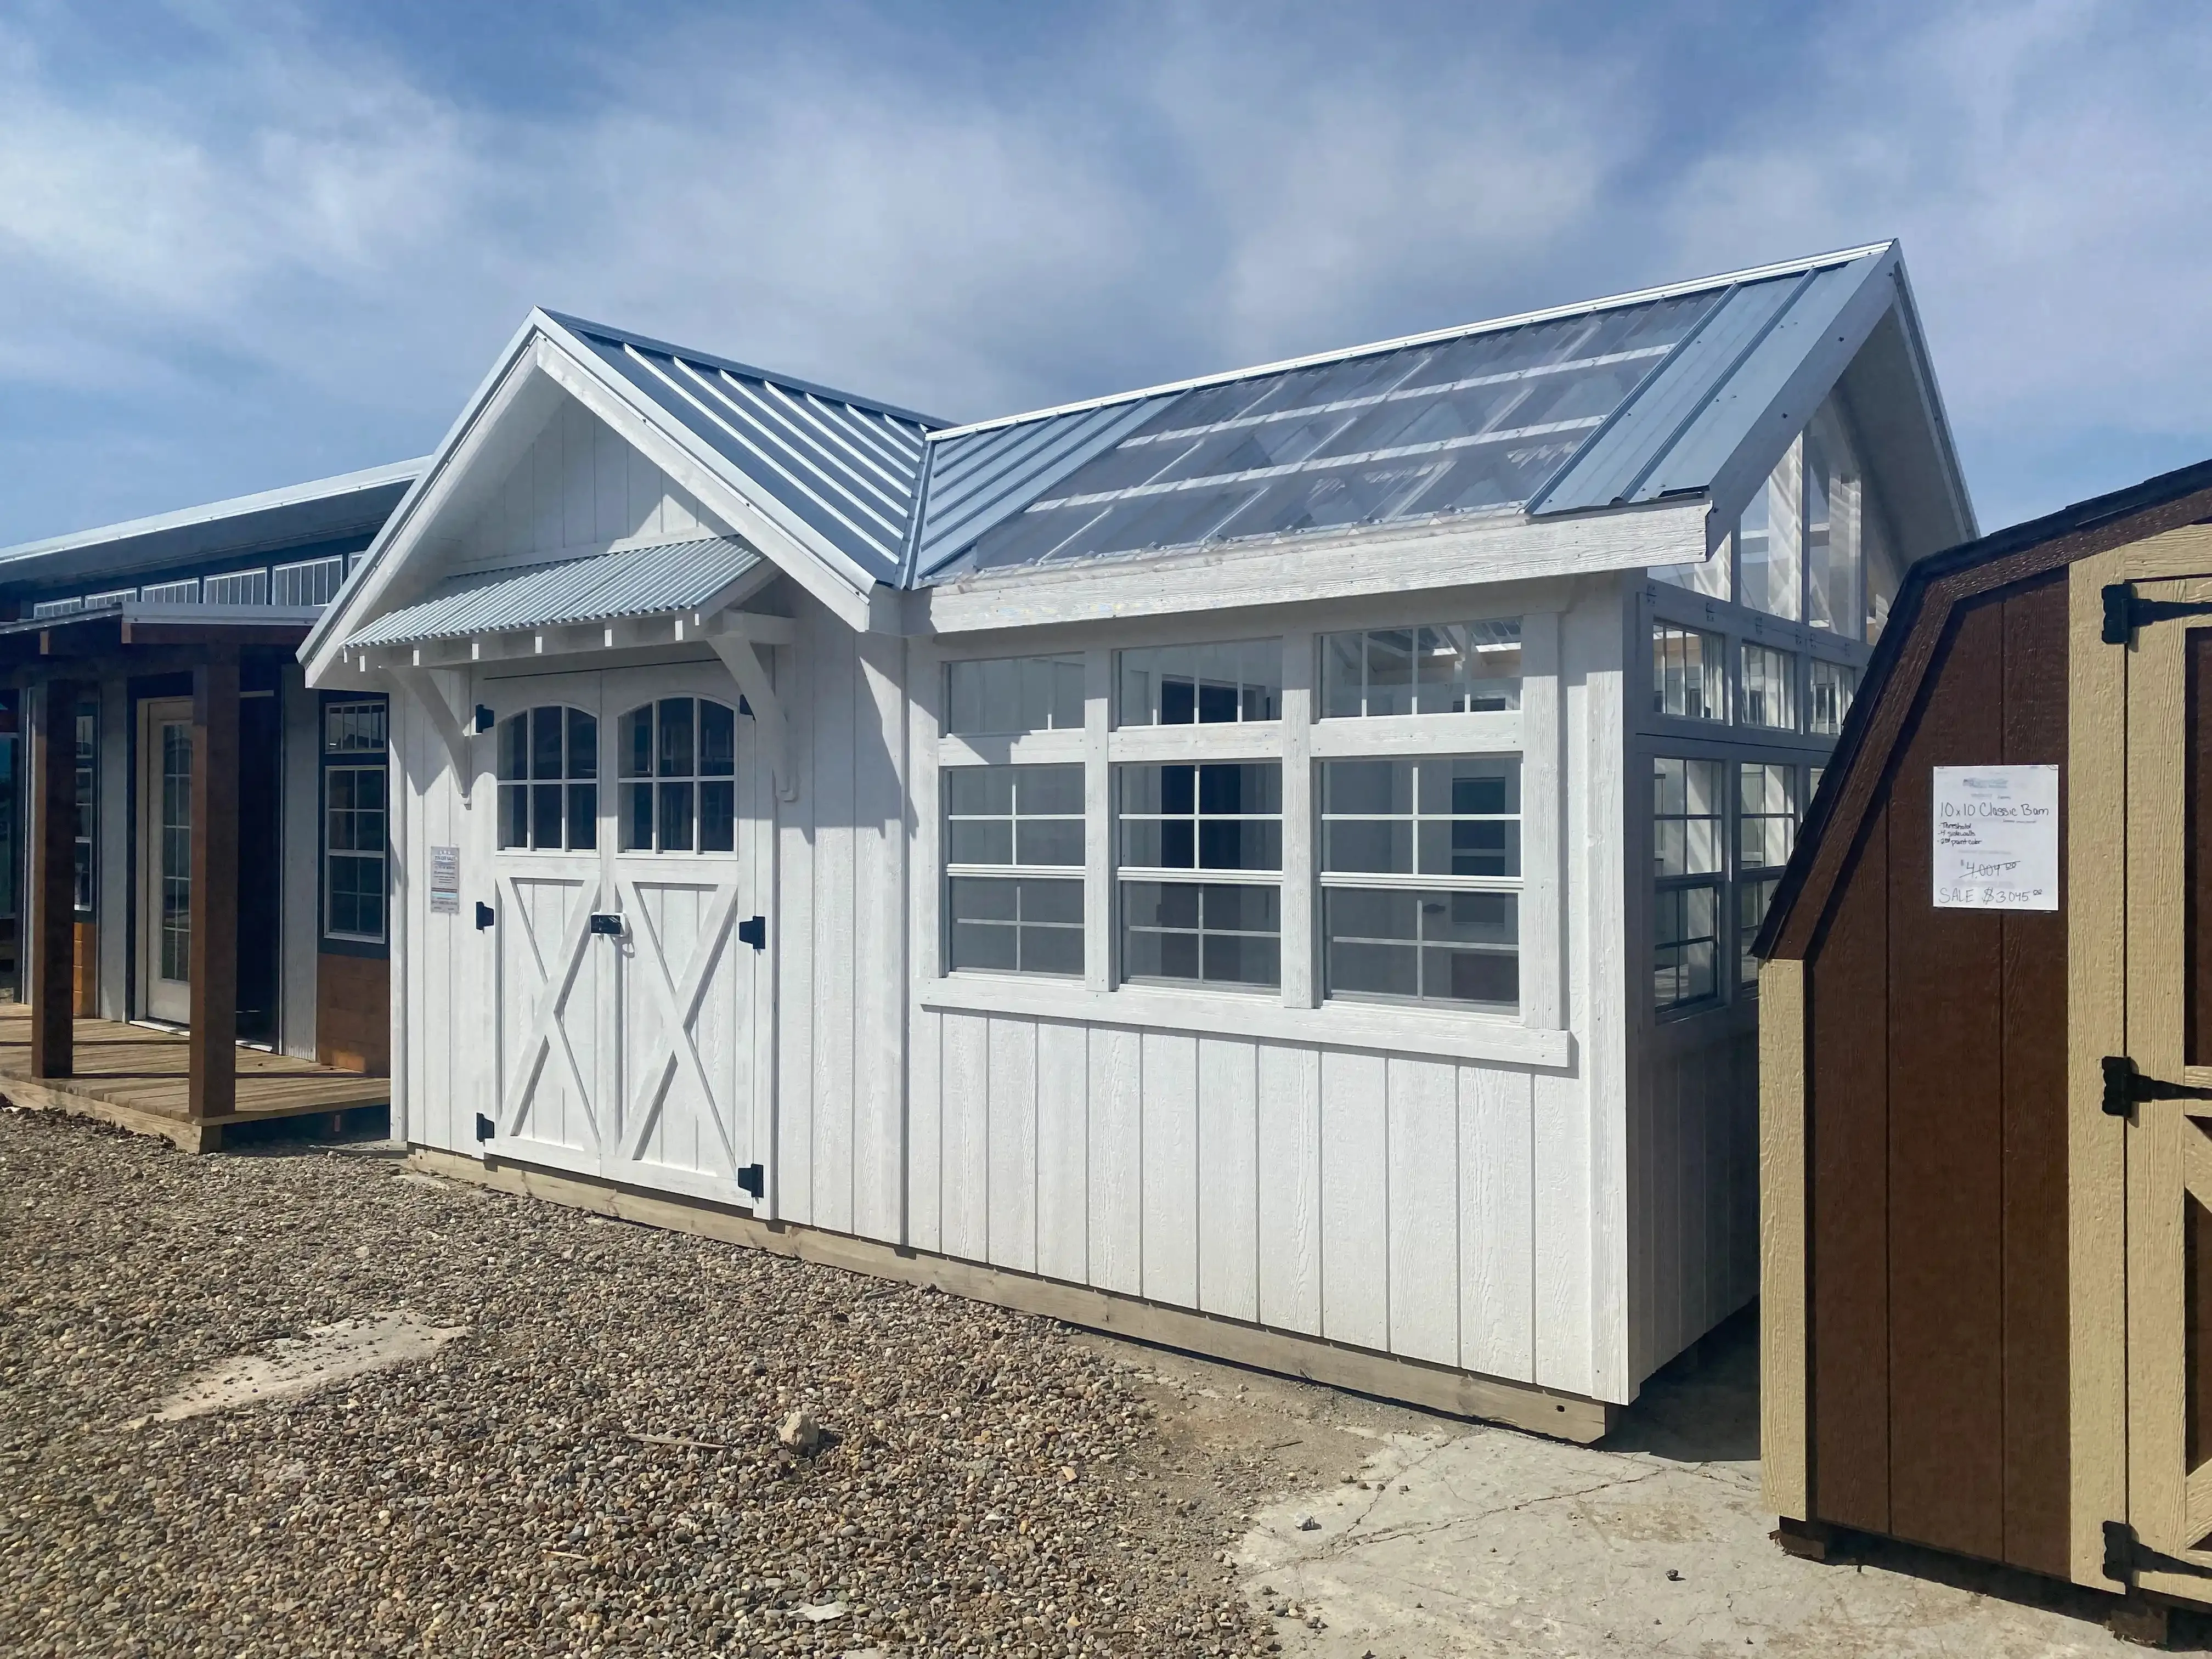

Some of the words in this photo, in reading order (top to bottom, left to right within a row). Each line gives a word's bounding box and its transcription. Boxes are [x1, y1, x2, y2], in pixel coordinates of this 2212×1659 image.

[1980, 802, 2018, 817] Classic
[2021, 803, 2049, 816] Barn
[1939, 887, 1974, 903] SALE
